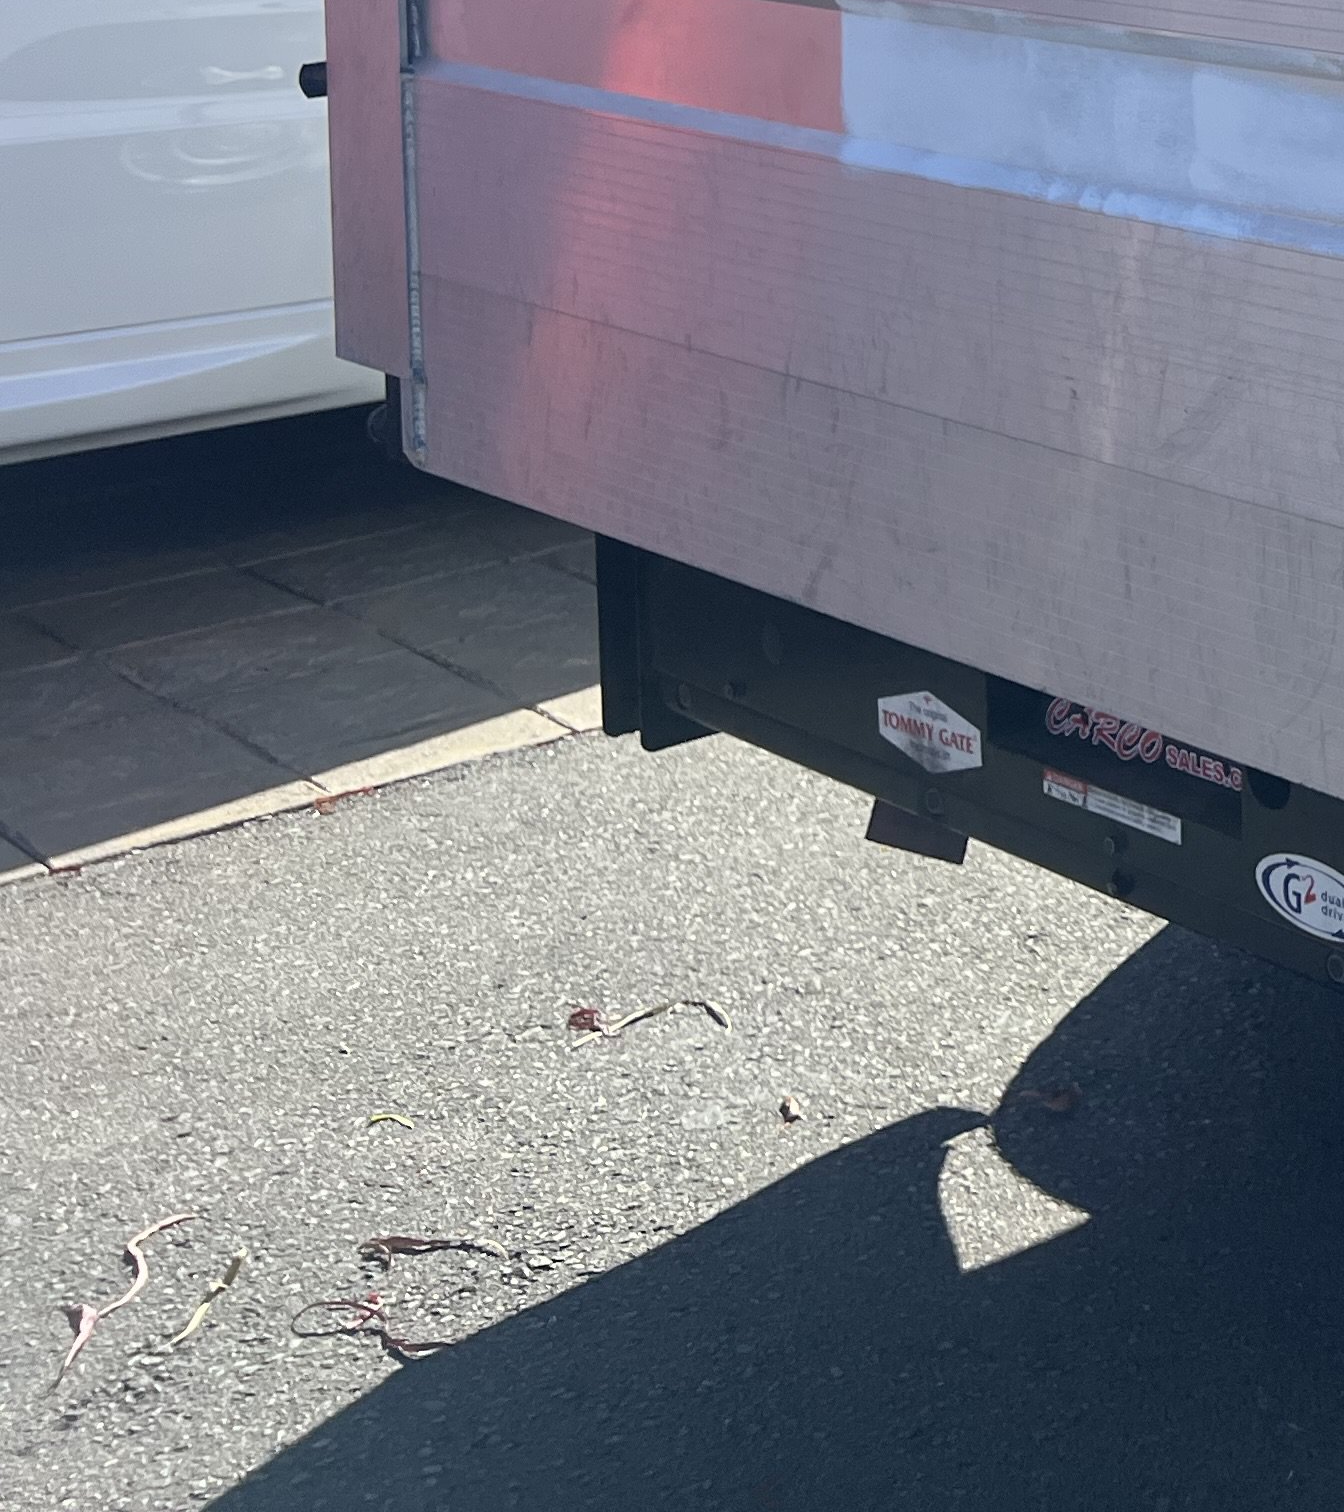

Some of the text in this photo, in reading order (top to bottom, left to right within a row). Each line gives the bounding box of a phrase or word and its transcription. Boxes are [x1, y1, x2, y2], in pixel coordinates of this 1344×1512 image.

[882, 709, 934, 742] TOMMY
[938, 728, 974, 755] GATE
[1046, 697, 1163, 763] CARCO
[1321, 891, 1344, 910] dual
